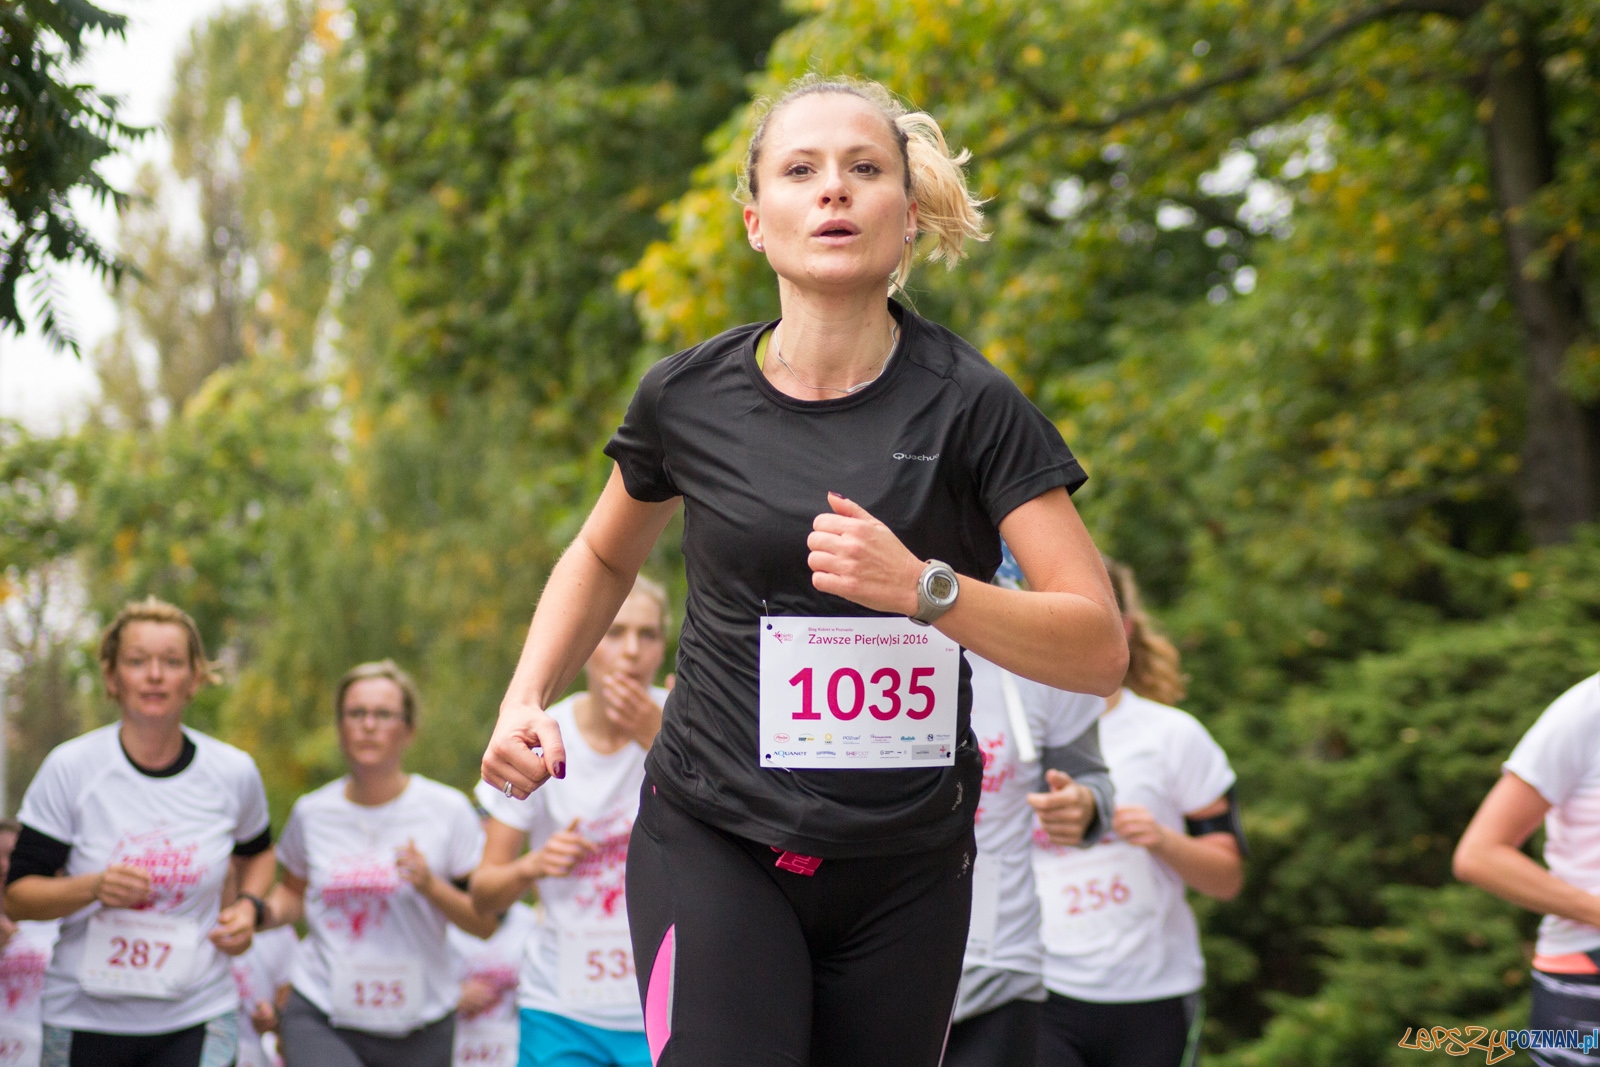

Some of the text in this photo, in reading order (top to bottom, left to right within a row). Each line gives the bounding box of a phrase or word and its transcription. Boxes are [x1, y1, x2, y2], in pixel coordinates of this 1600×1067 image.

[808, 634, 929, 646] Zawsze Pier(w)si 2016
[788, 667, 936, 721] 1035
[1061, 873, 1131, 916] 256
[107, 936, 173, 971] 287
[586, 949, 637, 983] 53
[354, 981, 406, 1007] 125
